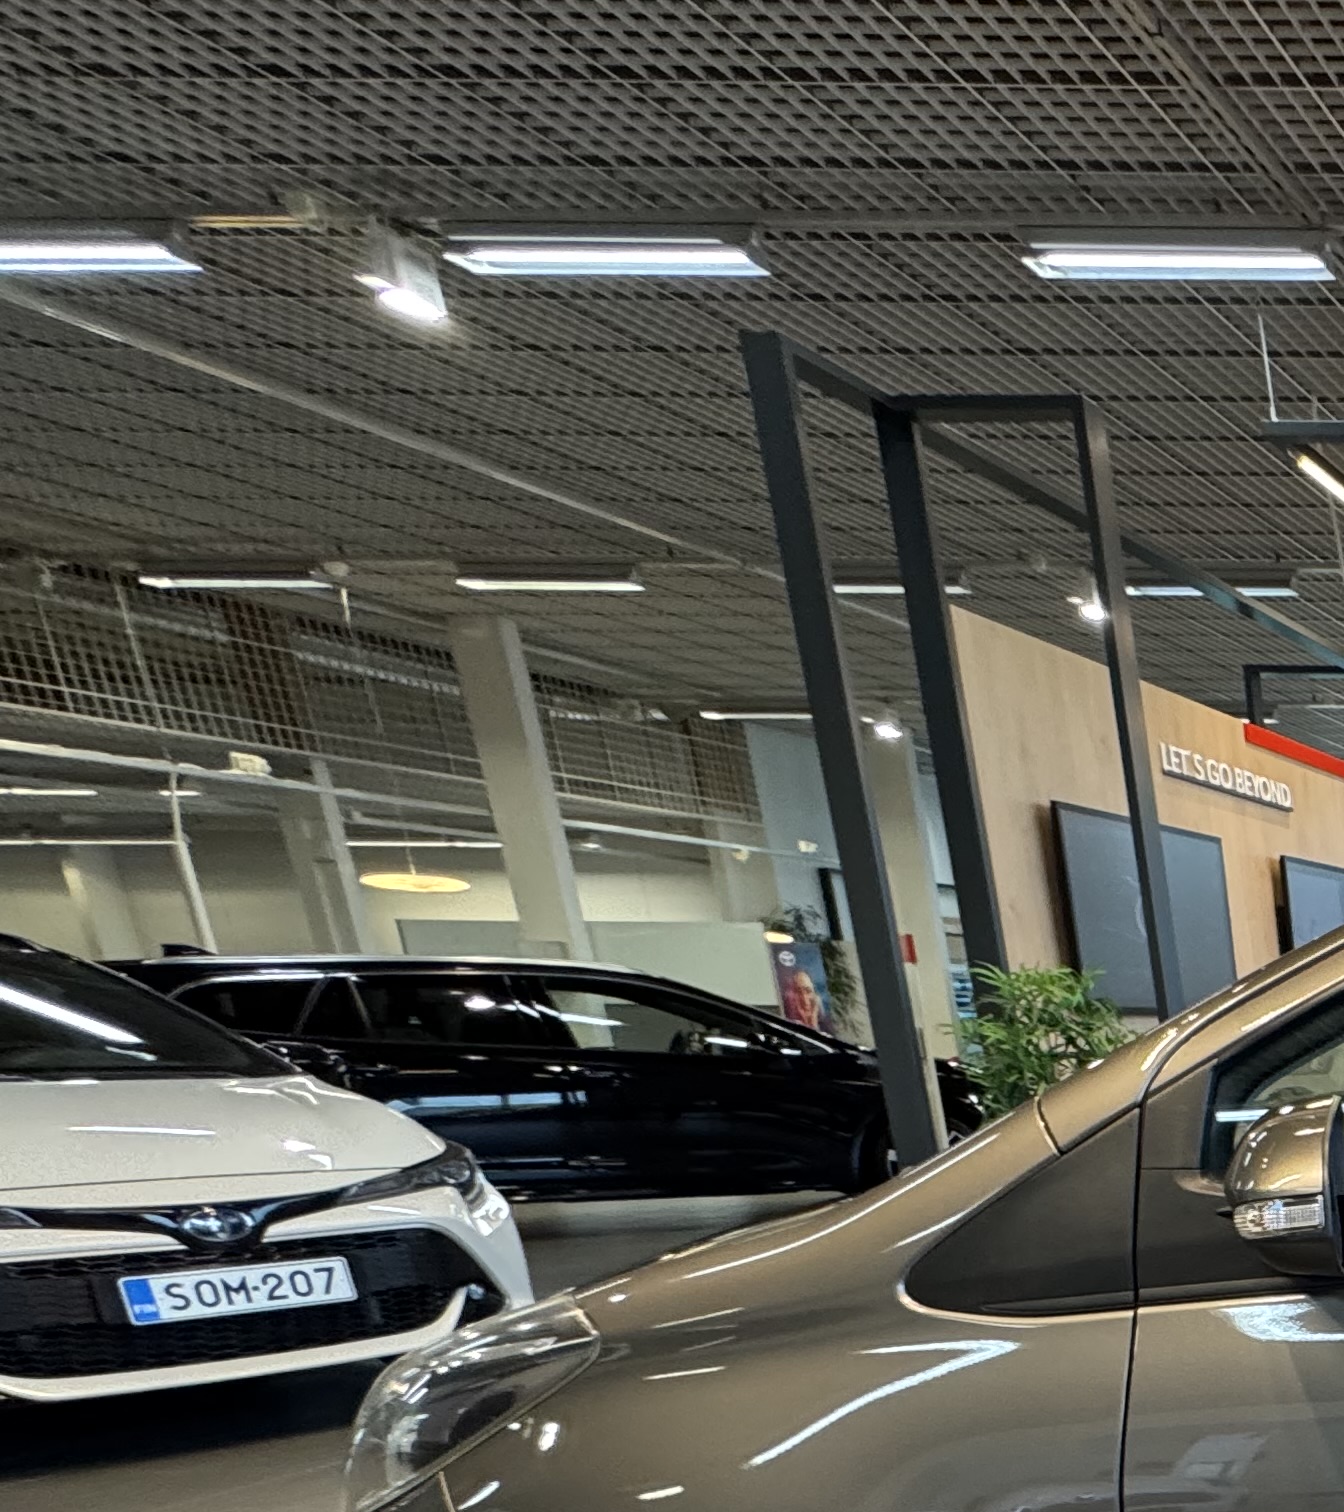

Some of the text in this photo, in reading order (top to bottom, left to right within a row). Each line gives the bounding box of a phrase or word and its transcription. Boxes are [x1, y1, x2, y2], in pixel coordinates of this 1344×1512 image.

[1205, 758, 1234, 790] GO
[1233, 767, 1292, 808] BEYOND
[164, 1266, 336, 1311] SOM-207
